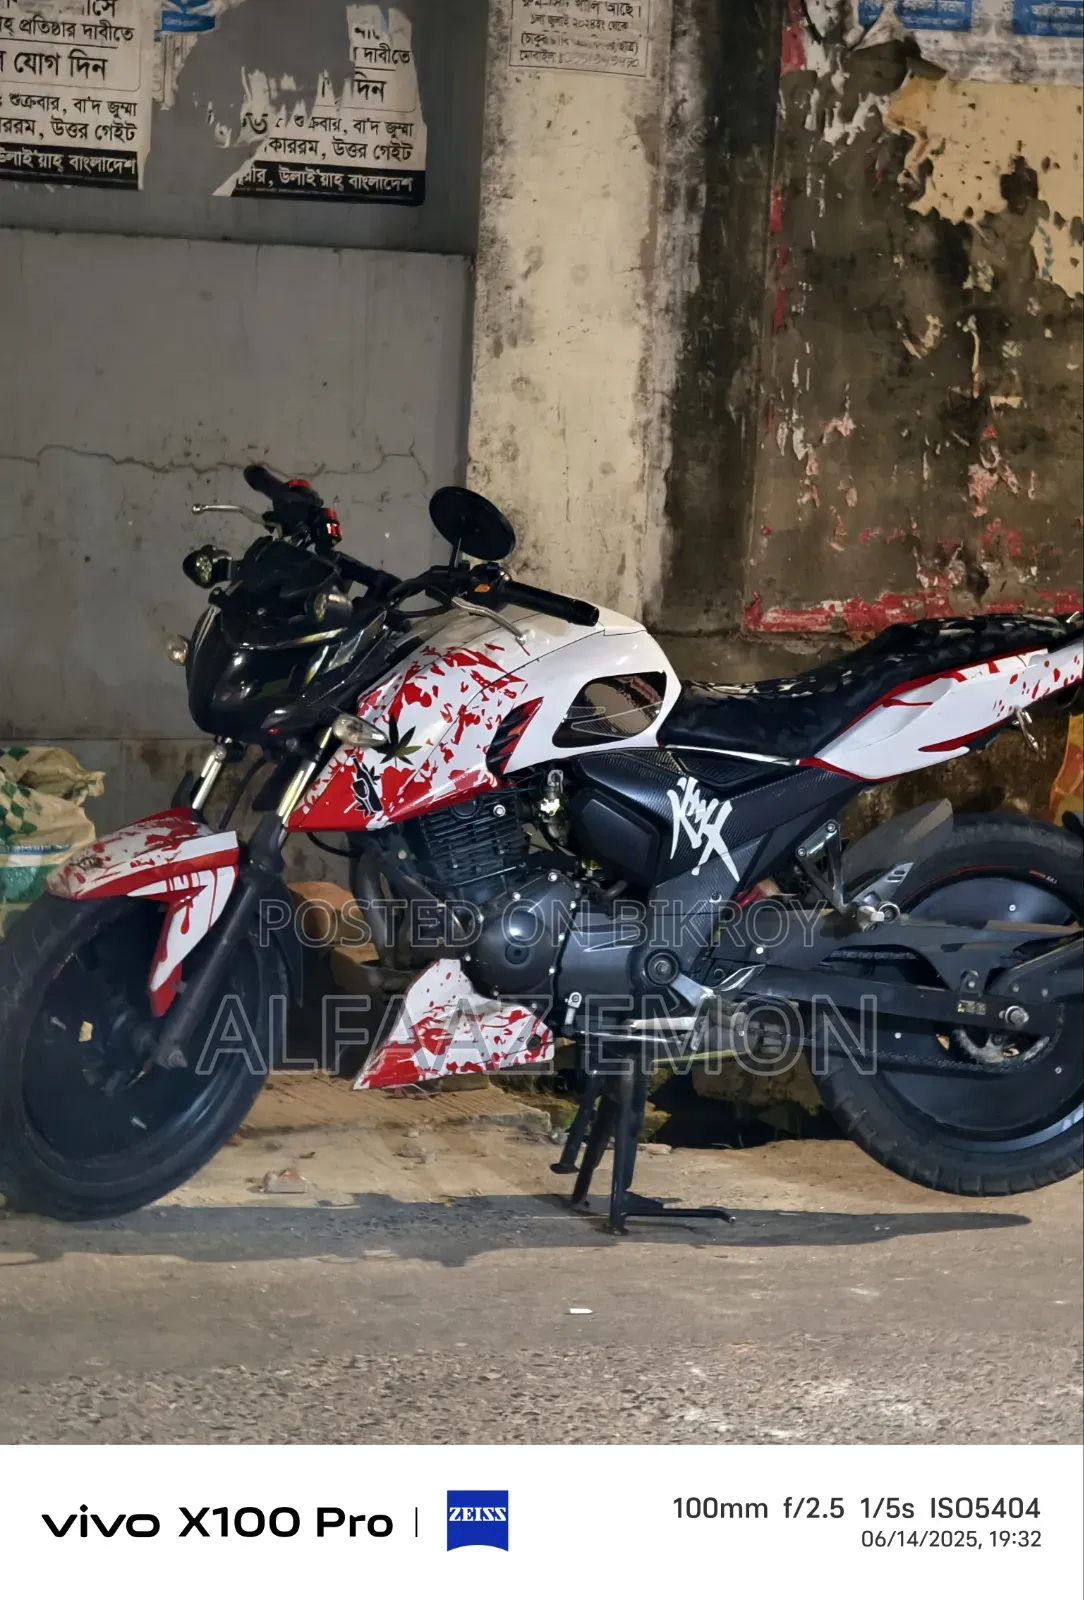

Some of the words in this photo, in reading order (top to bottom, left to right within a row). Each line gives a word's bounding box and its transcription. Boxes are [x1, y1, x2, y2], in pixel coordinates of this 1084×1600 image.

[19, 15, 76, 39] প্রতিষ্ঠার
[81, 20, 135, 42] দাবীতে
[14, 52, 62, 77] যোগ
[68, 48, 109, 81] দিন
[363, 43, 411, 65] দাবীতে
[50, 115, 88, 140] উত্তর
[95, 120, 138, 142] গেইট
[331, 136, 369, 160] উত্তর
[373, 140, 413, 162] গেইট
[68, 153, 137, 175] বাংলাদেশ
[348, 173, 414, 194] বাংলাদেশ
